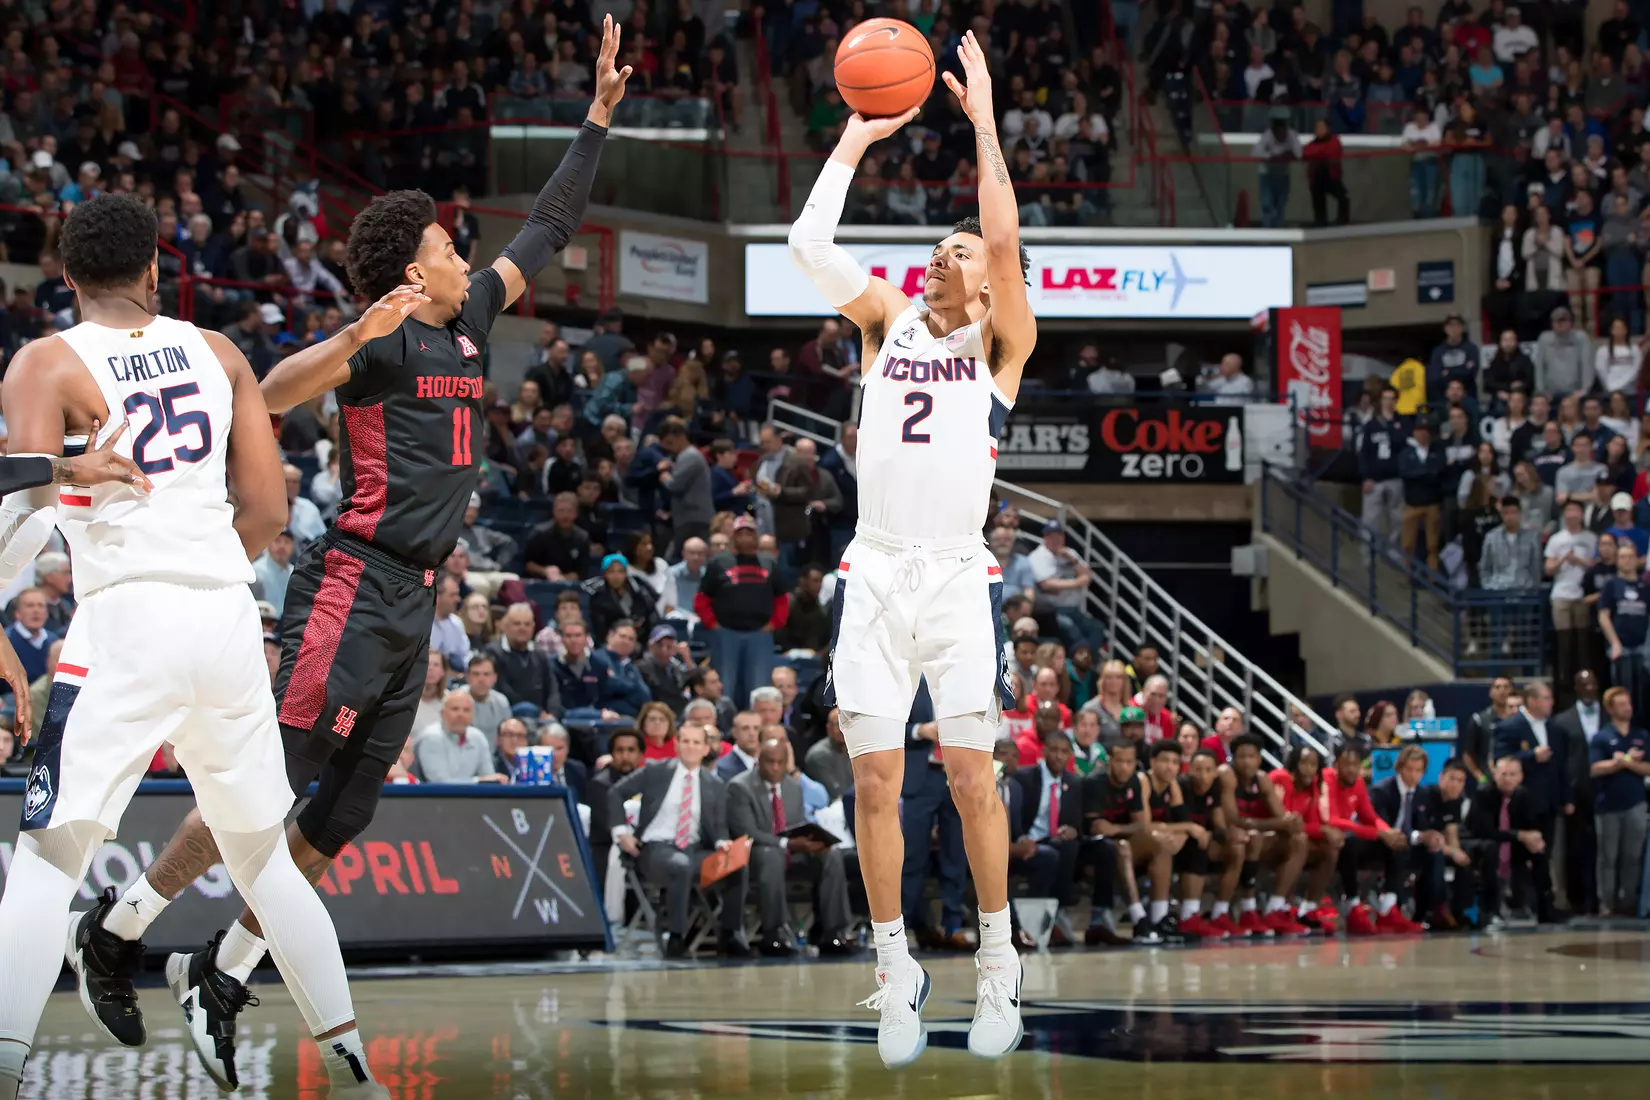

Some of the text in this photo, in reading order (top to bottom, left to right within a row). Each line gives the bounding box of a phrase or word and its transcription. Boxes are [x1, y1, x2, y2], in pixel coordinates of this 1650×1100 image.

[1042, 267, 1167, 292] LAZ FLY
[107, 345, 191, 382] CARLTON
[882, 354, 977, 384] UCONN
[1289, 319, 1333, 435] C-Cola
[416, 375, 483, 399] HOUSTO
[123, 381, 213, 476] 25
[901, 391, 934, 444] 2
[1102, 408, 1223, 454] Coke
[451, 406, 473, 466] 11
[1120, 453, 1204, 478] zero
[511, 808, 531, 835] B
[490, 853, 513, 879] N
[557, 853, 576, 878] E
[533, 898, 560, 924] W
